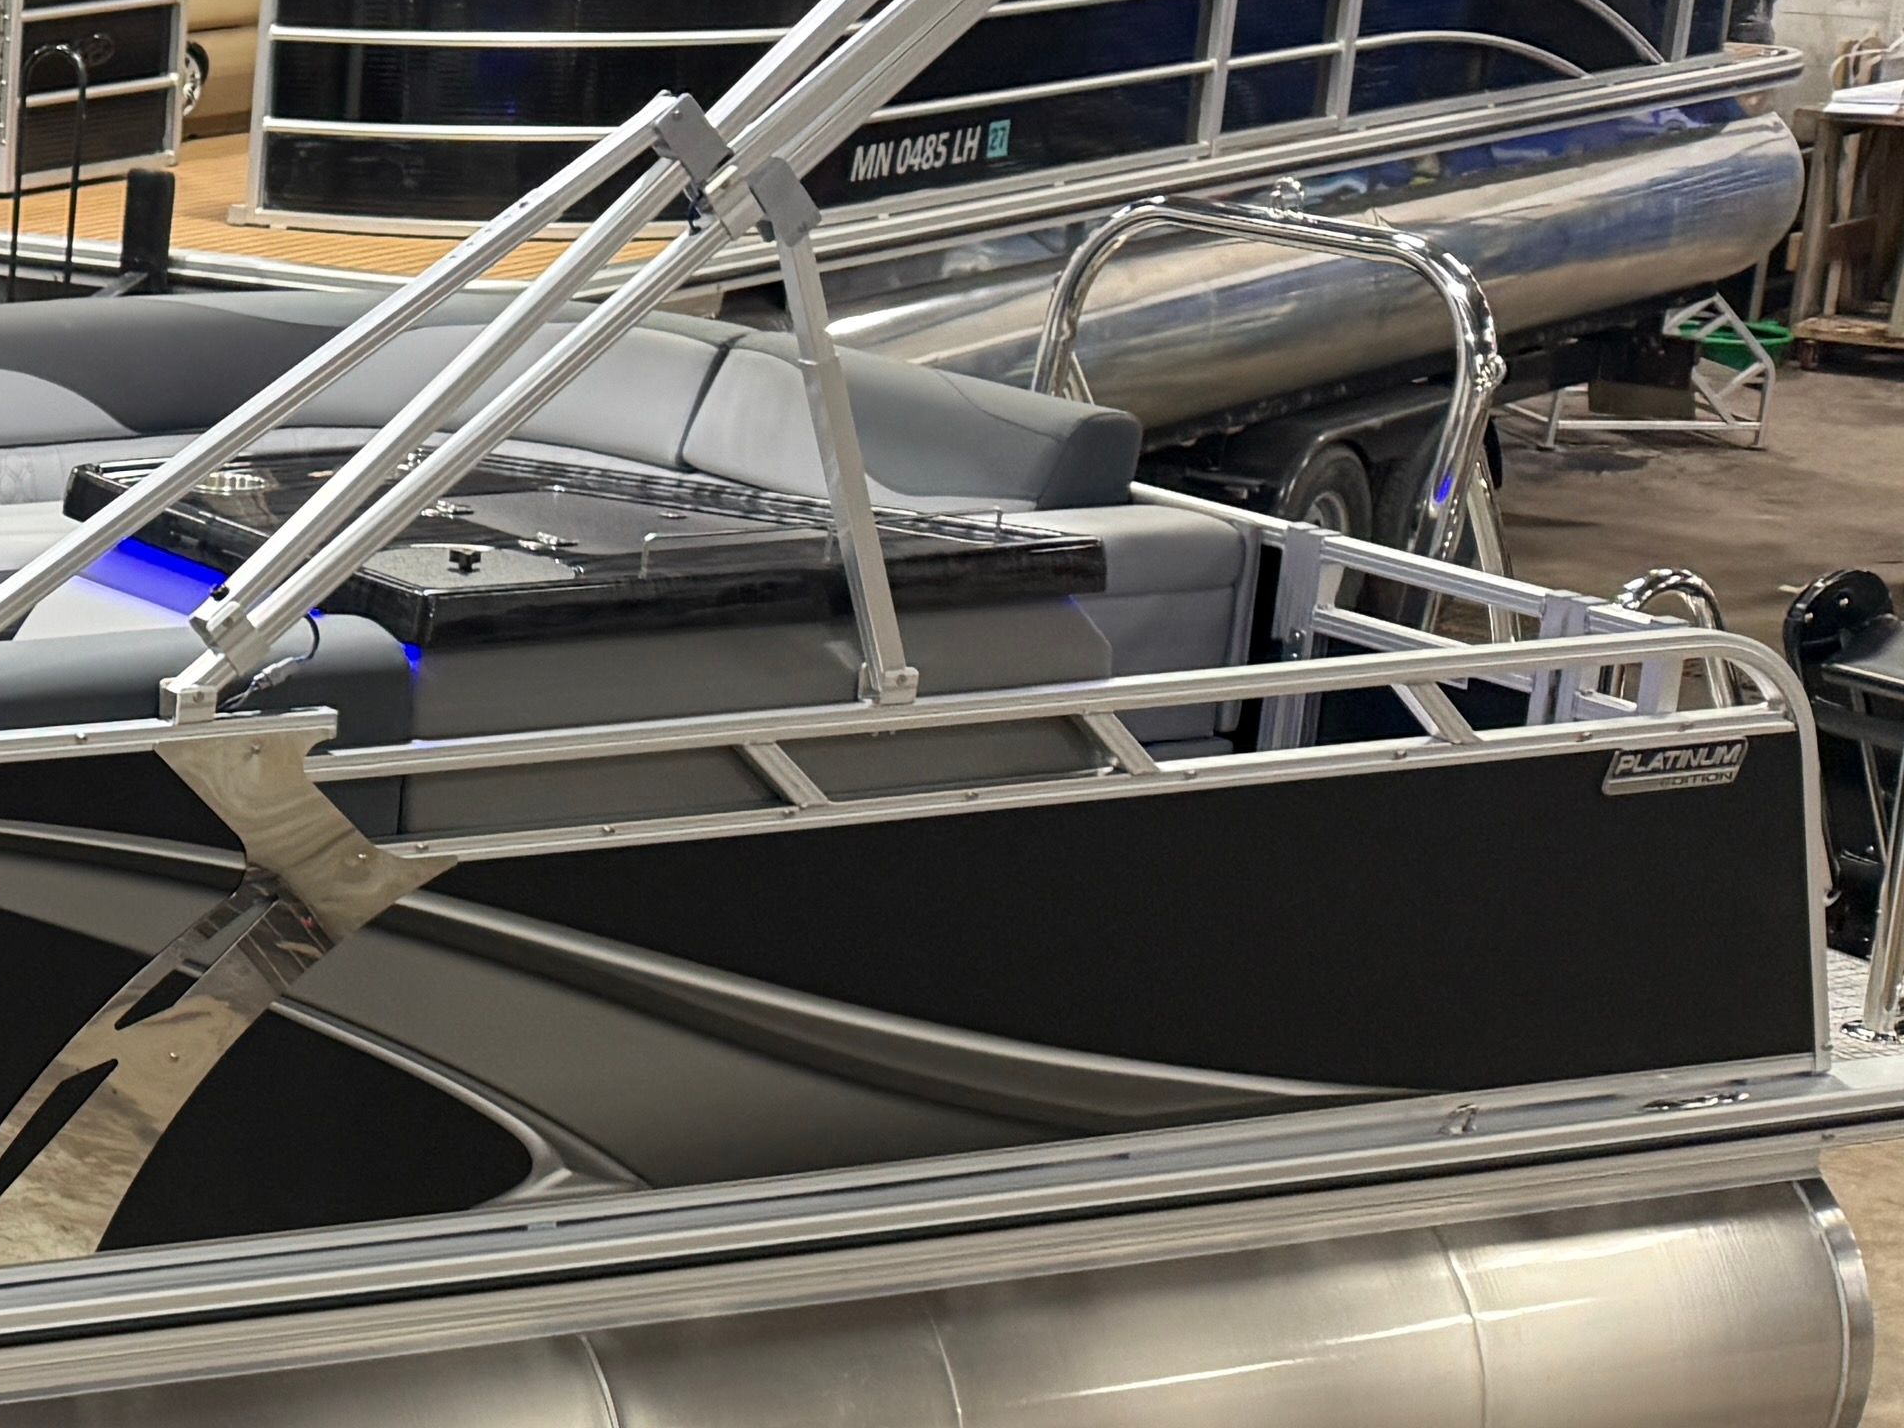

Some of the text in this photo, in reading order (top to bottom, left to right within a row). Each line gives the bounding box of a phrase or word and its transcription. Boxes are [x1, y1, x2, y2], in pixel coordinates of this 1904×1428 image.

[989, 126, 1007, 151] 27
[850, 125, 982, 182] MN 0485 LH
[1614, 743, 1743, 775] PLATINUM
[1659, 771, 1733, 787] EDITION
